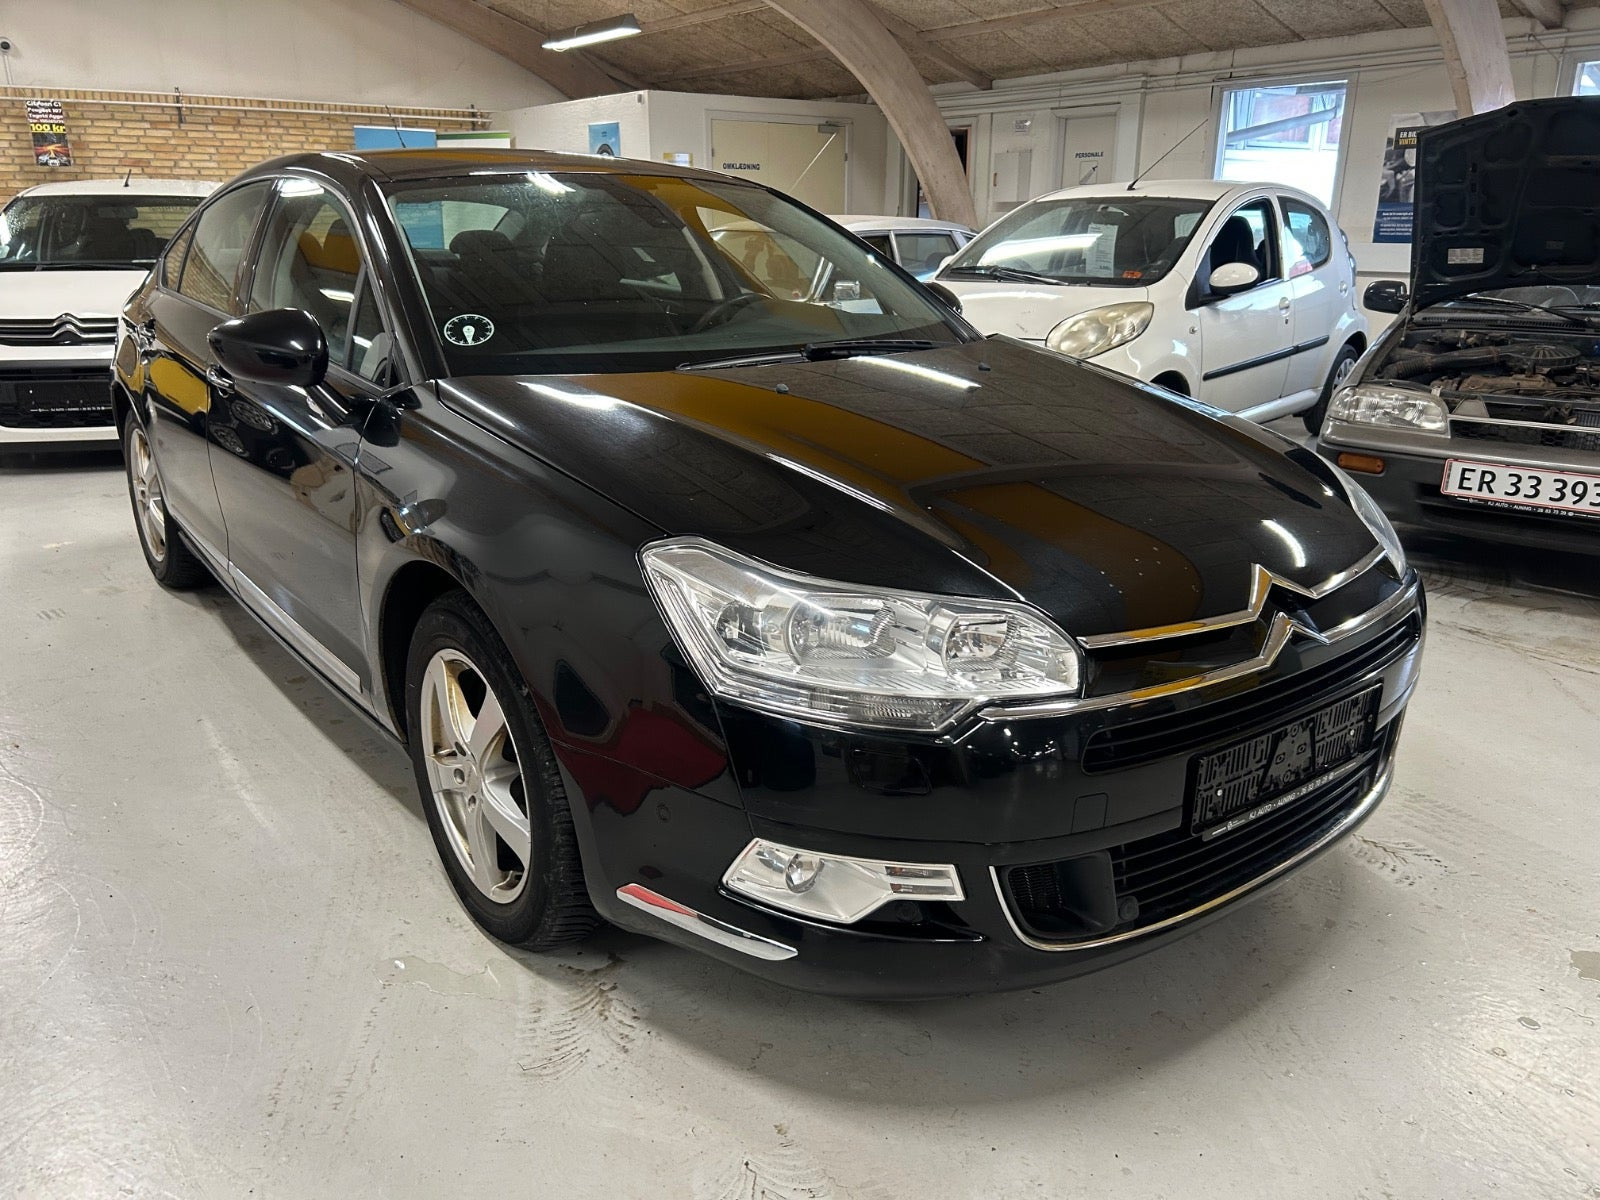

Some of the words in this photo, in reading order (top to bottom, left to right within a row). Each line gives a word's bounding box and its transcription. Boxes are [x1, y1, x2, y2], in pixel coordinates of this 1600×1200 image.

[1458, 467, 1496, 494] ER
[1504, 473, 1542, 499] 33
[1549, 478, 1600, 507] 393
[1257, 804, 1272, 817] AUTO
